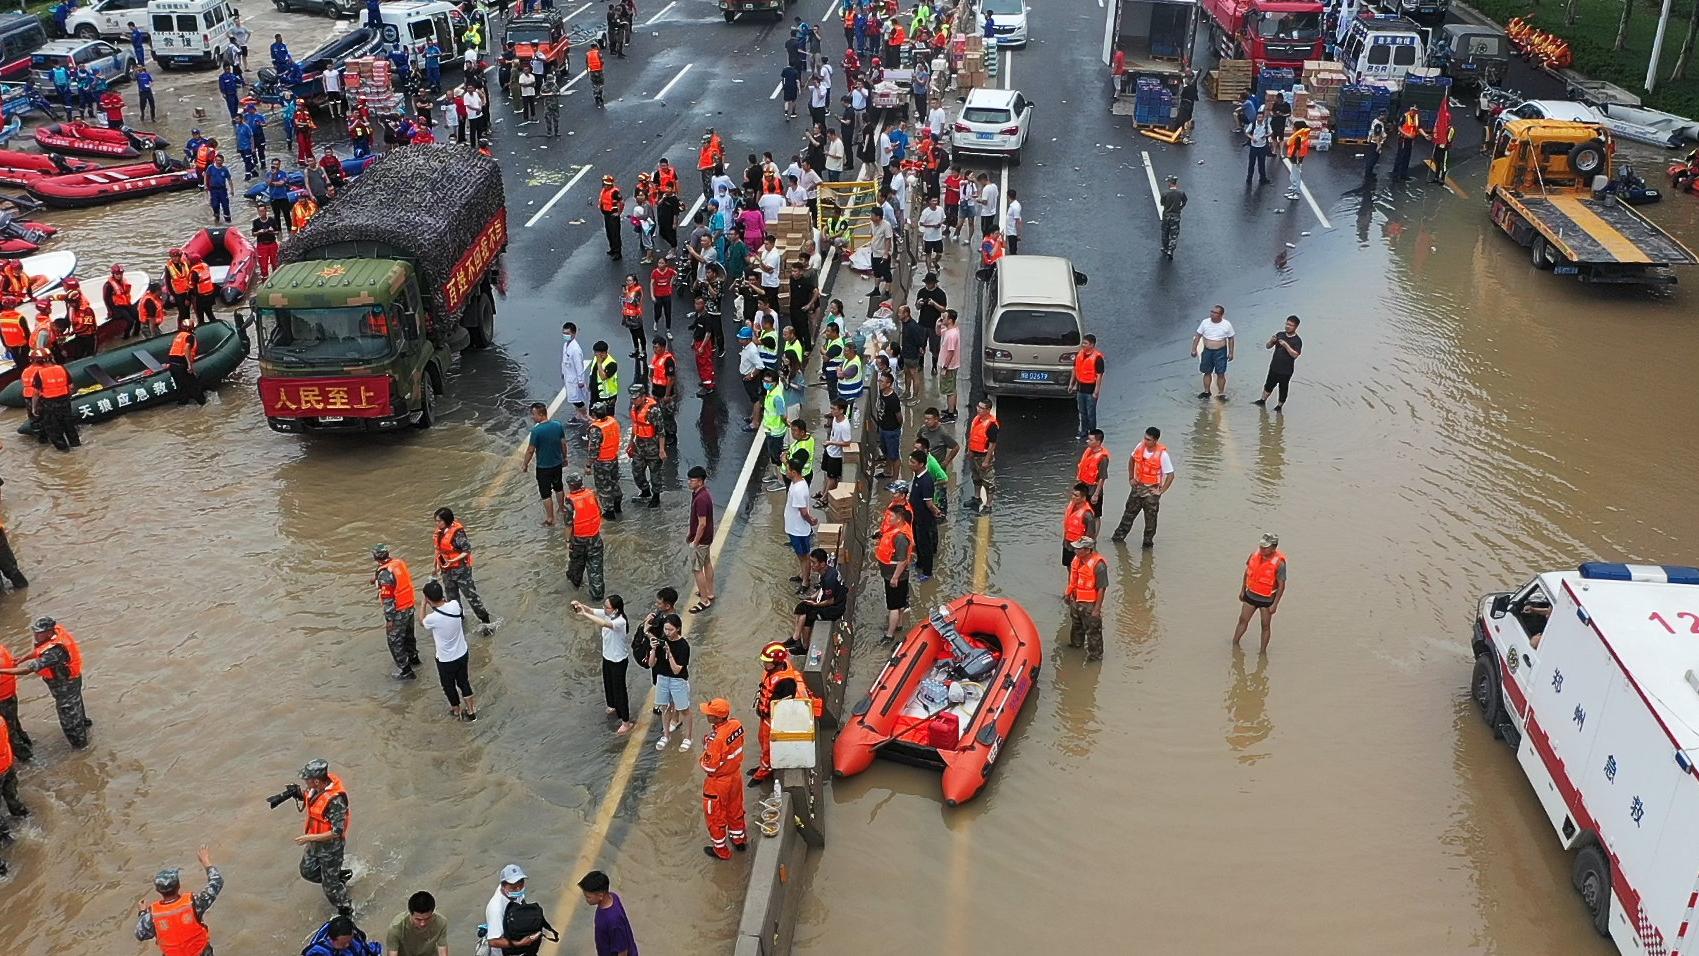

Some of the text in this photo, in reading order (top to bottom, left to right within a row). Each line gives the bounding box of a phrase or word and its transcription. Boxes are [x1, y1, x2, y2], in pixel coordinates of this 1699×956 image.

[1367, 65, 1388, 73] BSR
[78, 376, 177, 419] 天狼应急救
[274, 385, 379, 411] 人民至上
